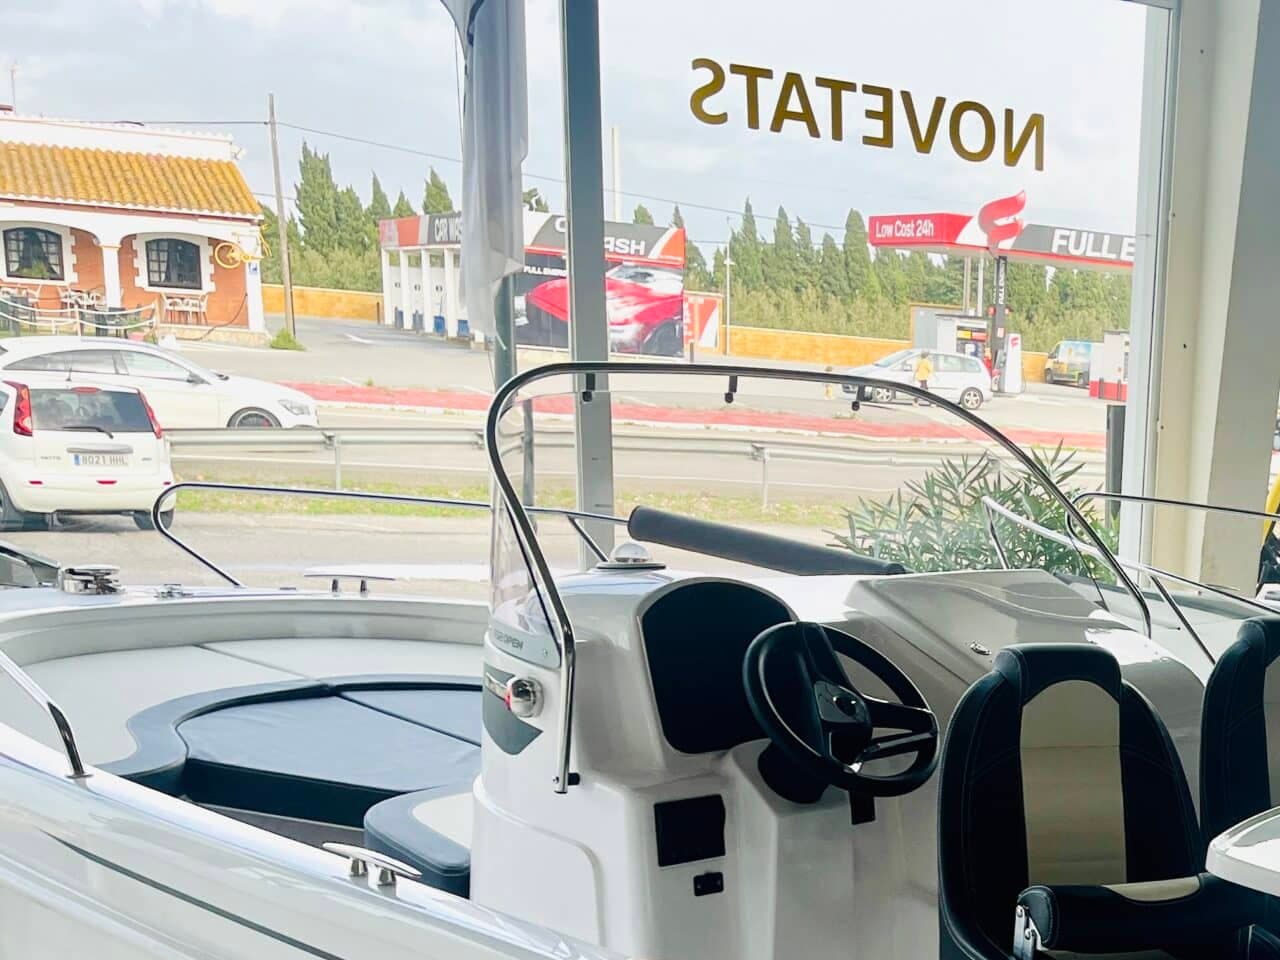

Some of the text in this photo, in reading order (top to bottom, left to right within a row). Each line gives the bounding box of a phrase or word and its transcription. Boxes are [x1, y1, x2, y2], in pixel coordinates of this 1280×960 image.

[875, 219, 934, 238] Low Cost 24h
[605, 236, 645, 255] ASH
[1052, 229, 1117, 258] FULL
